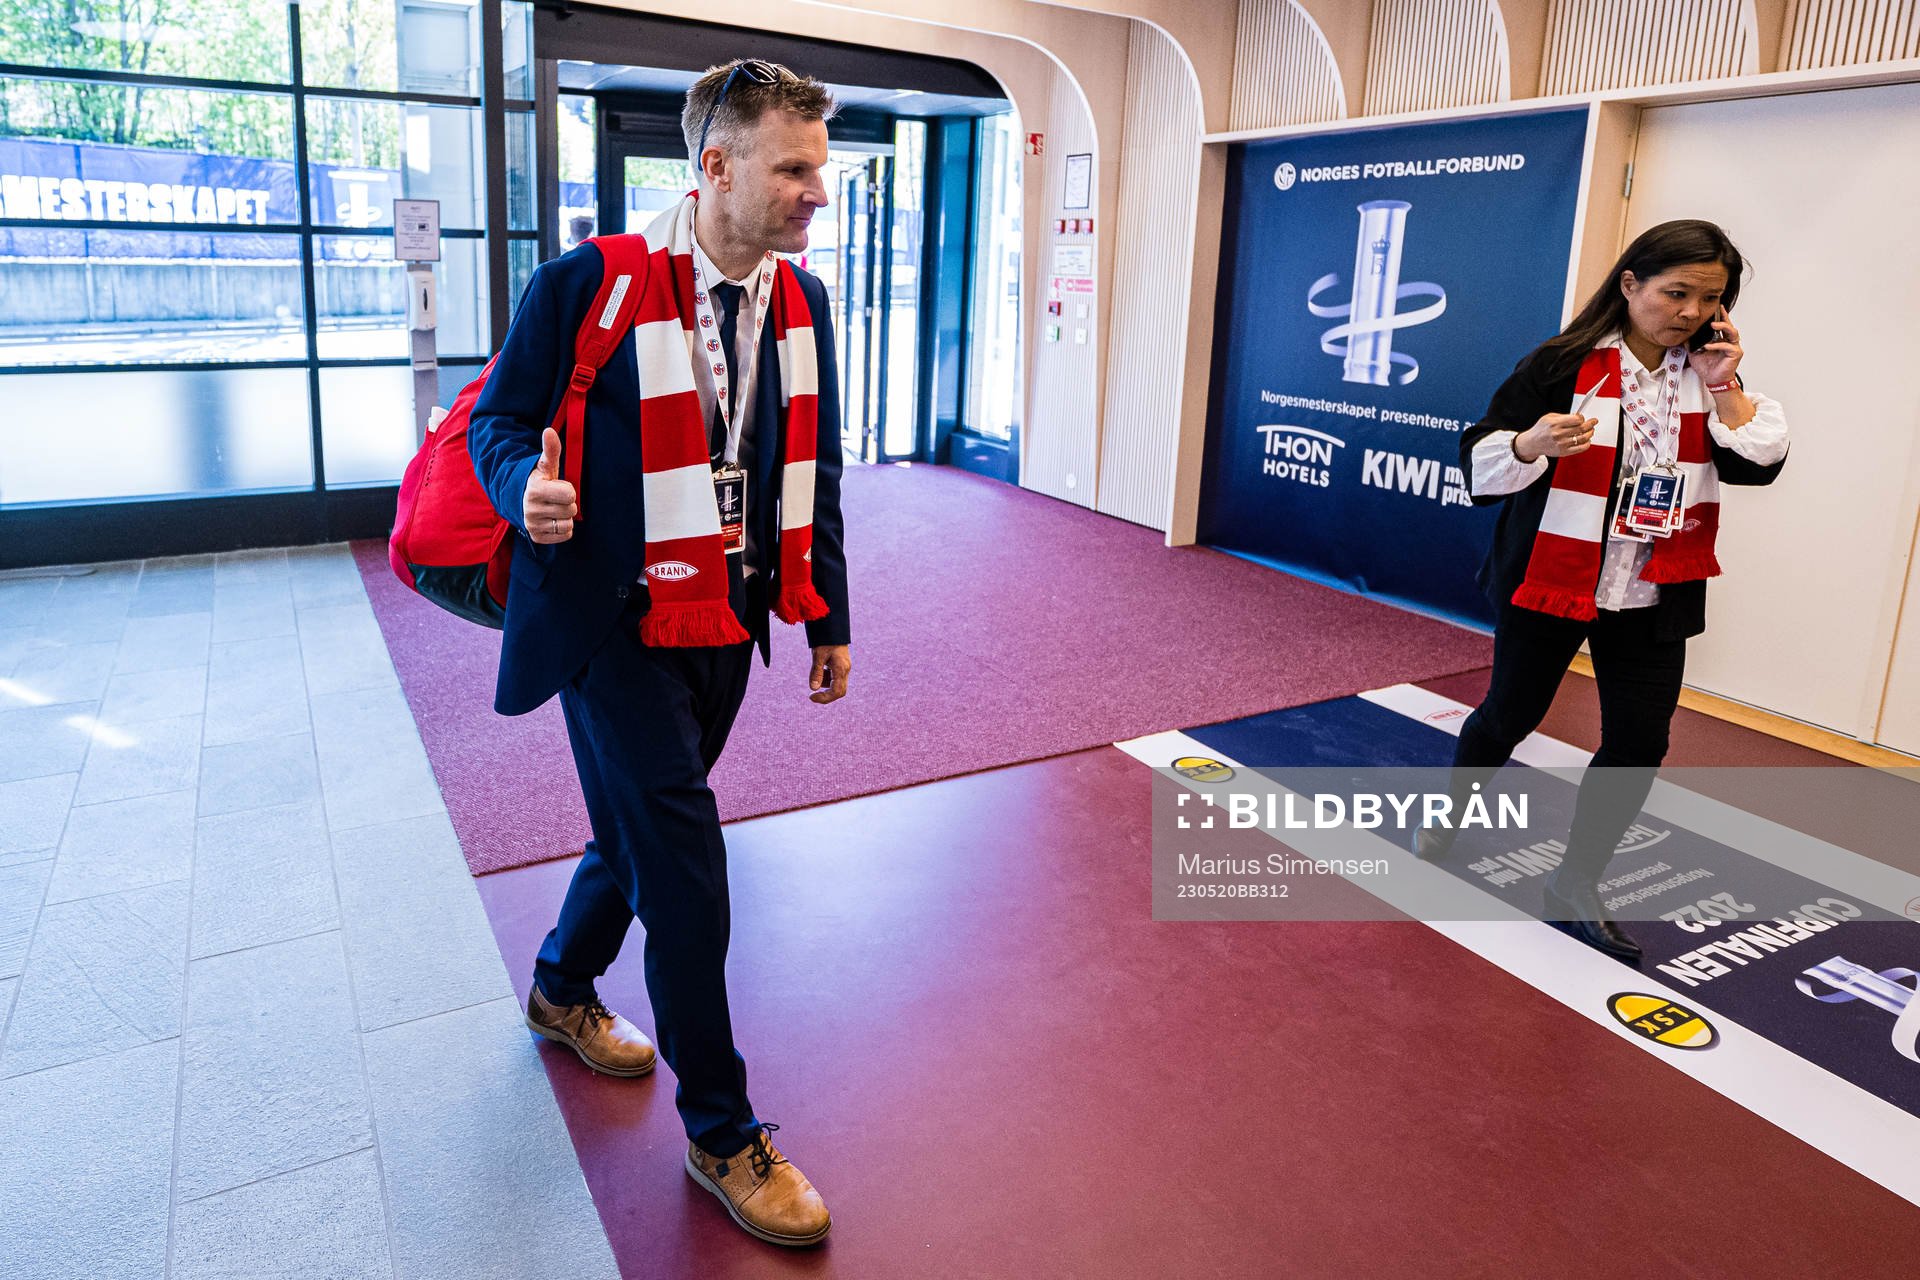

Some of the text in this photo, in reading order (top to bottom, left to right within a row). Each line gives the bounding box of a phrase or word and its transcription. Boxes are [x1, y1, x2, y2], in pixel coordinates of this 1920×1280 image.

[1301, 153, 1526, 183] NORGES FOTBALLFORBUND
[0, 174, 270, 225] MESTERSKAPET
[1261, 389, 1376, 419] Norgesmesterskapet
[1381, 408, 1459, 432] presenteres
[1257, 424, 1346, 466] THON
[1263, 458, 1330, 488] HOTELS
[1361, 448, 1441, 500] KIWI
[654, 566, 689, 576] BRANN
[1613, 823, 1672, 854] THO
[1659, 891, 1756, 933] 2022
[1655, 897, 1862, 988] CUPFINALEN
[1636, 1006, 1690, 1034] LSK
